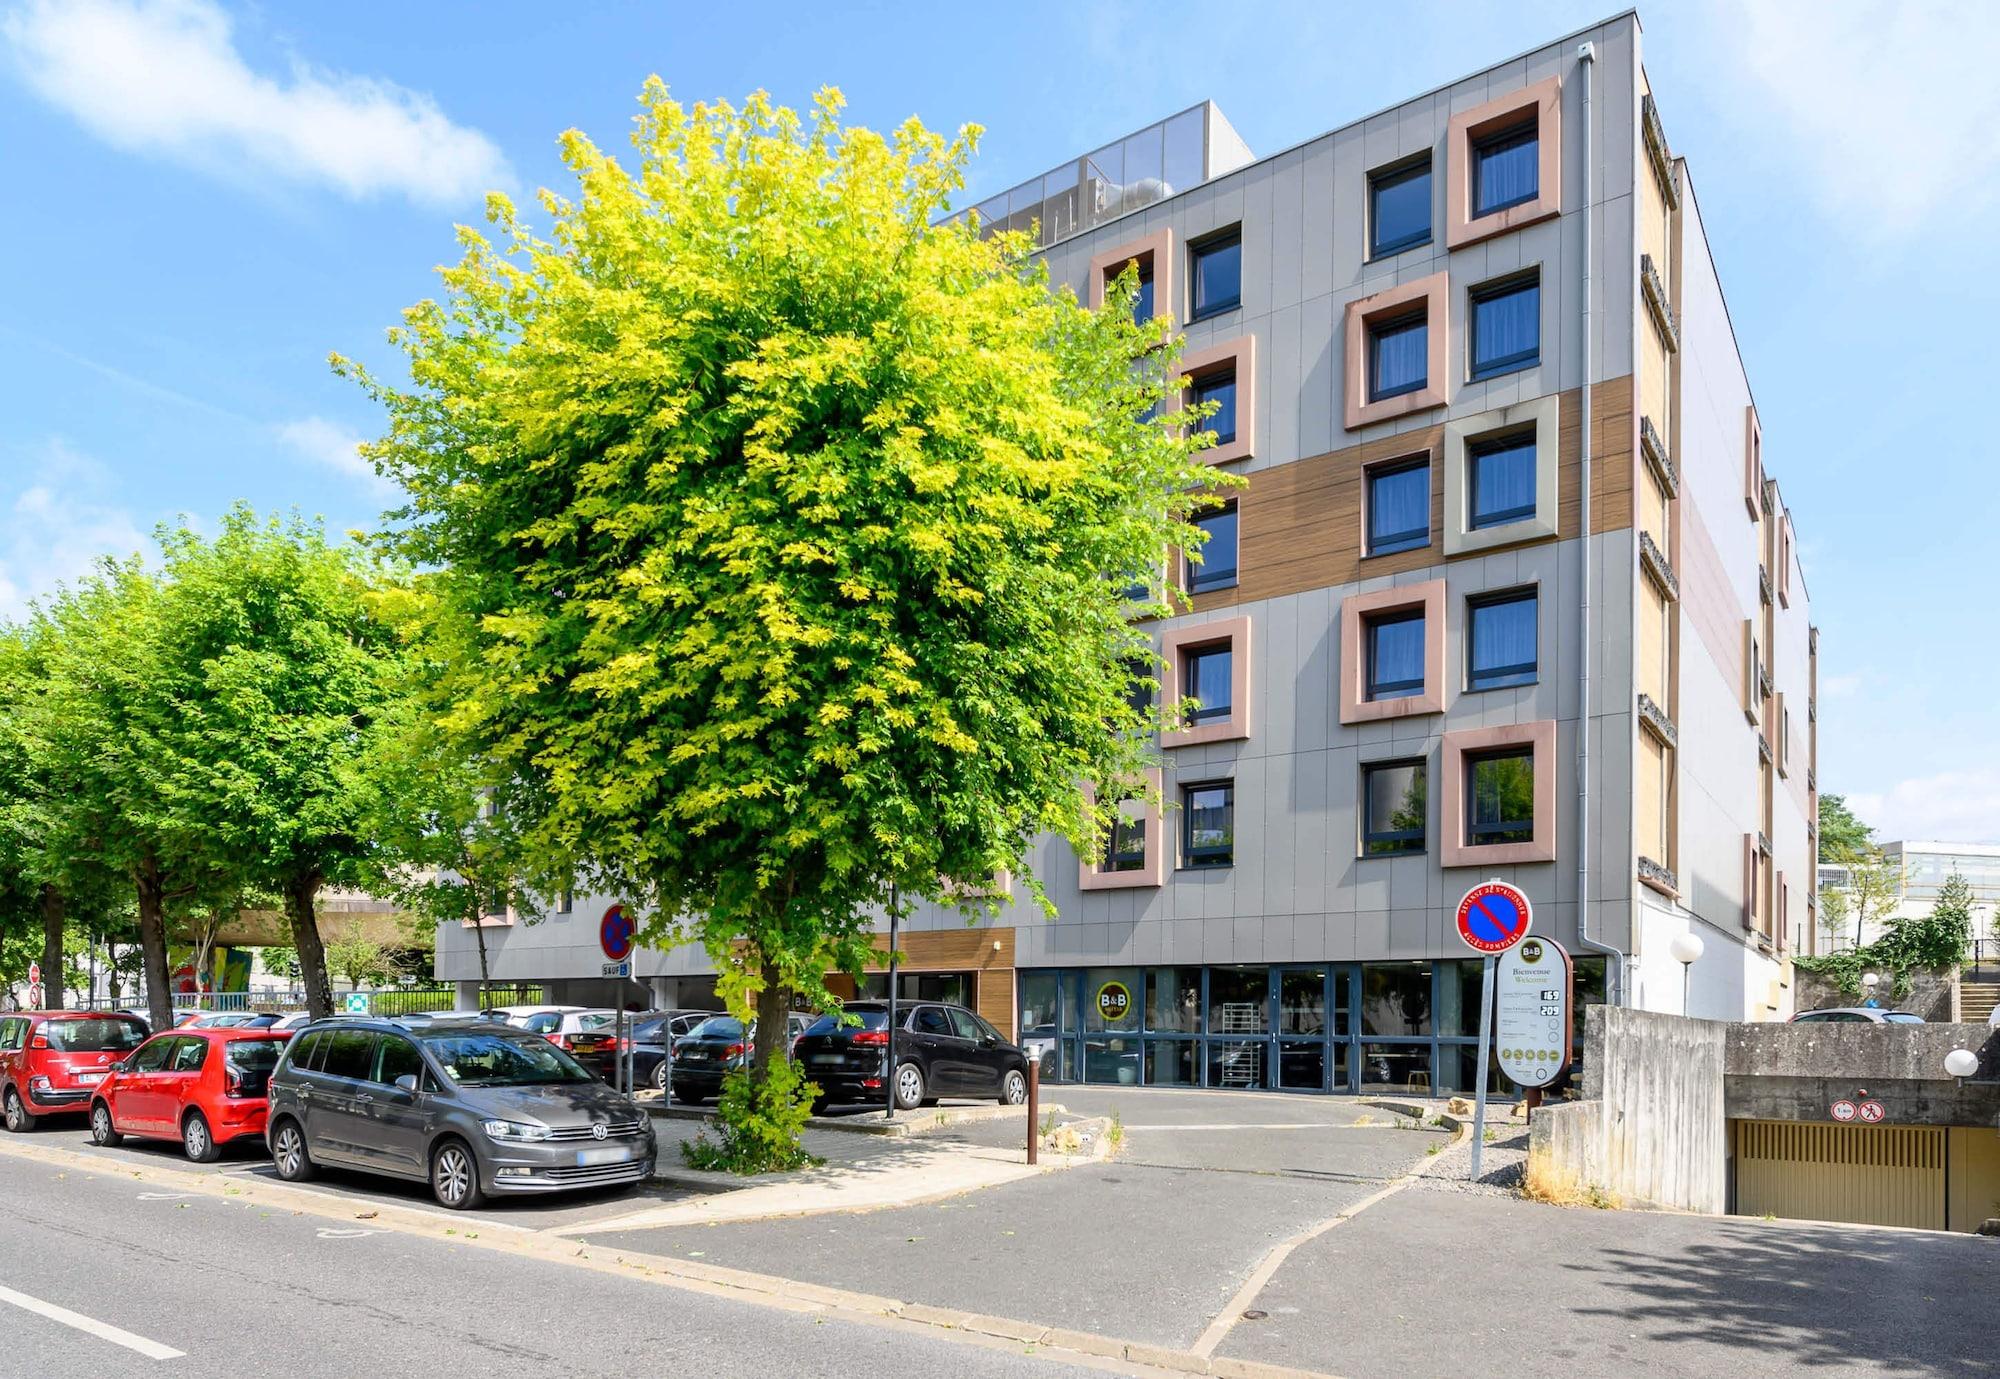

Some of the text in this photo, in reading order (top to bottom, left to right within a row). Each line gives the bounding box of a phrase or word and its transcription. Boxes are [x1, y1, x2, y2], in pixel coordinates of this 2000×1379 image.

[1523, 947, 1540, 955] B&B
[1512, 968, 1551, 976] Bienvenue
[1101, 994, 1127, 1007] B&B
[1540, 1006, 1559, 1016] 209
